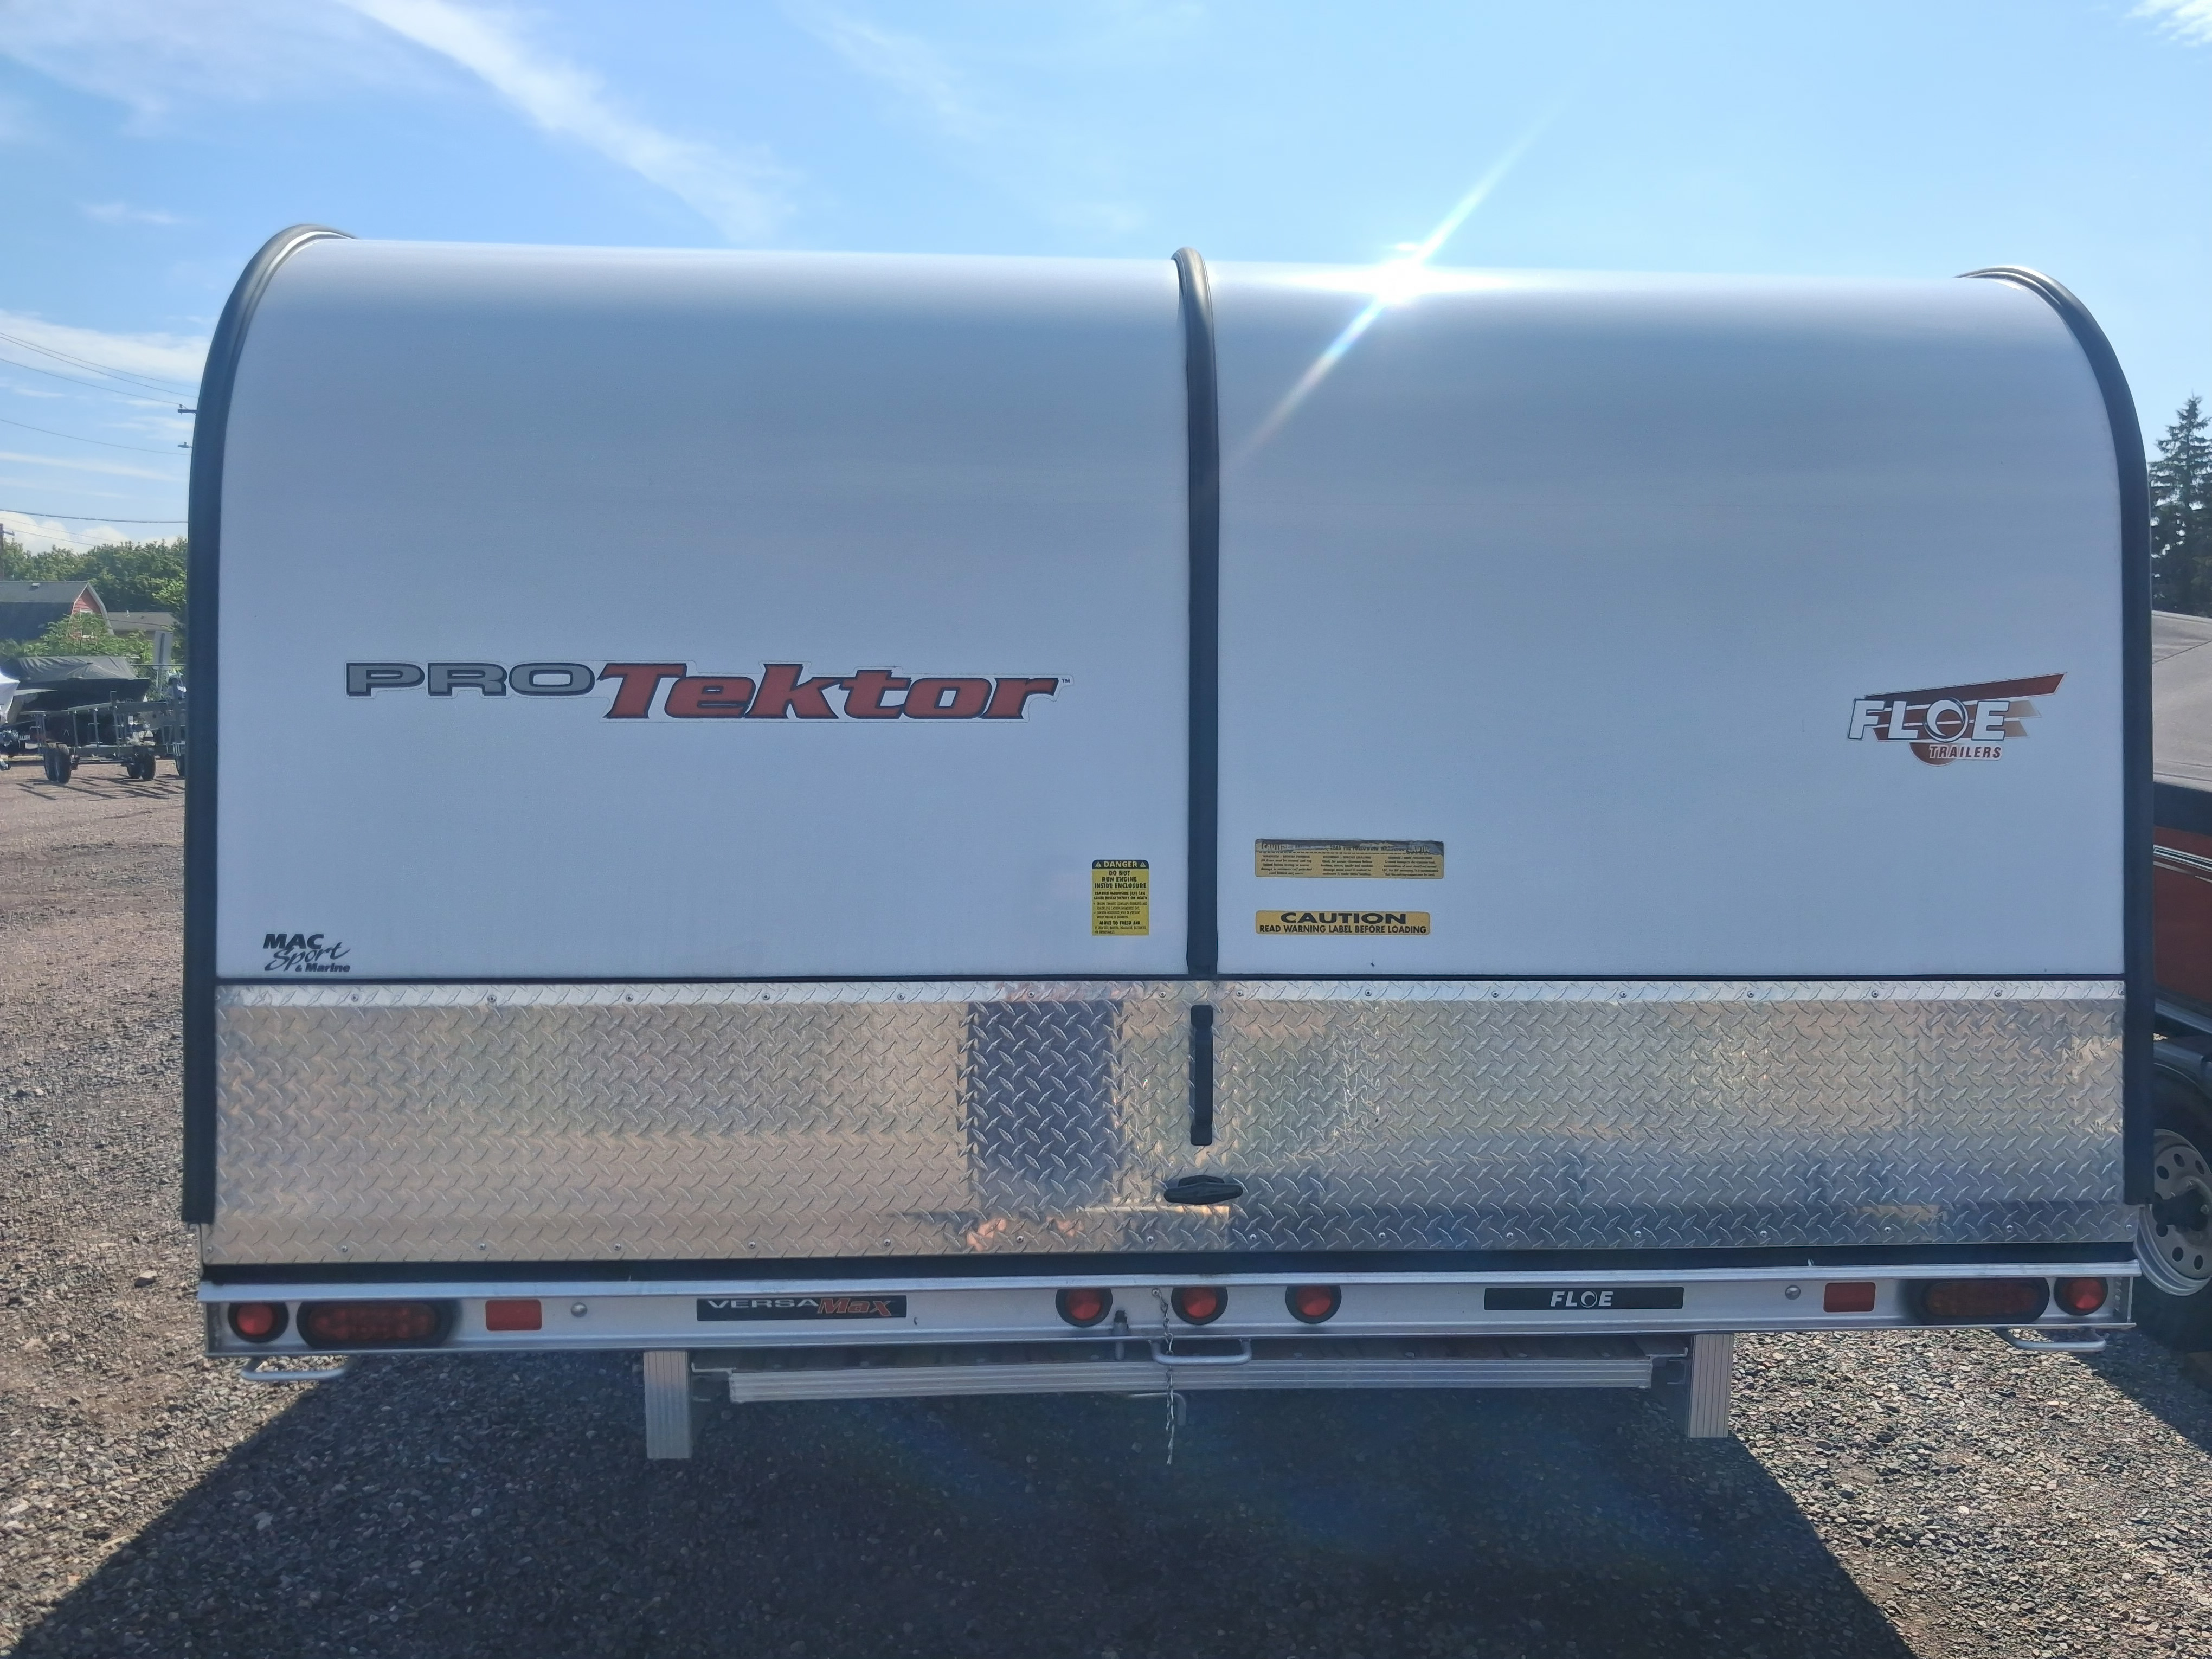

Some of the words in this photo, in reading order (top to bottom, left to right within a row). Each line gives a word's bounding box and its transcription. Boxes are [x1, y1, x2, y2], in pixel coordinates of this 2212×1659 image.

[1848, 697, 2010, 742] FLOE
[1930, 744, 2002, 759] TRAILERS
[1281, 912, 1406, 924] CAUTION
[1329, 925, 1352, 933] LABEL
[1355, 925, 1385, 933] BEFORE
[1388, 925, 1427, 934] LOADING
[263, 934, 324, 949] MAC
[265, 942, 351, 972] Sport
[305, 963, 350, 972] Marine
[1550, 1290, 1614, 1308] FLOE
